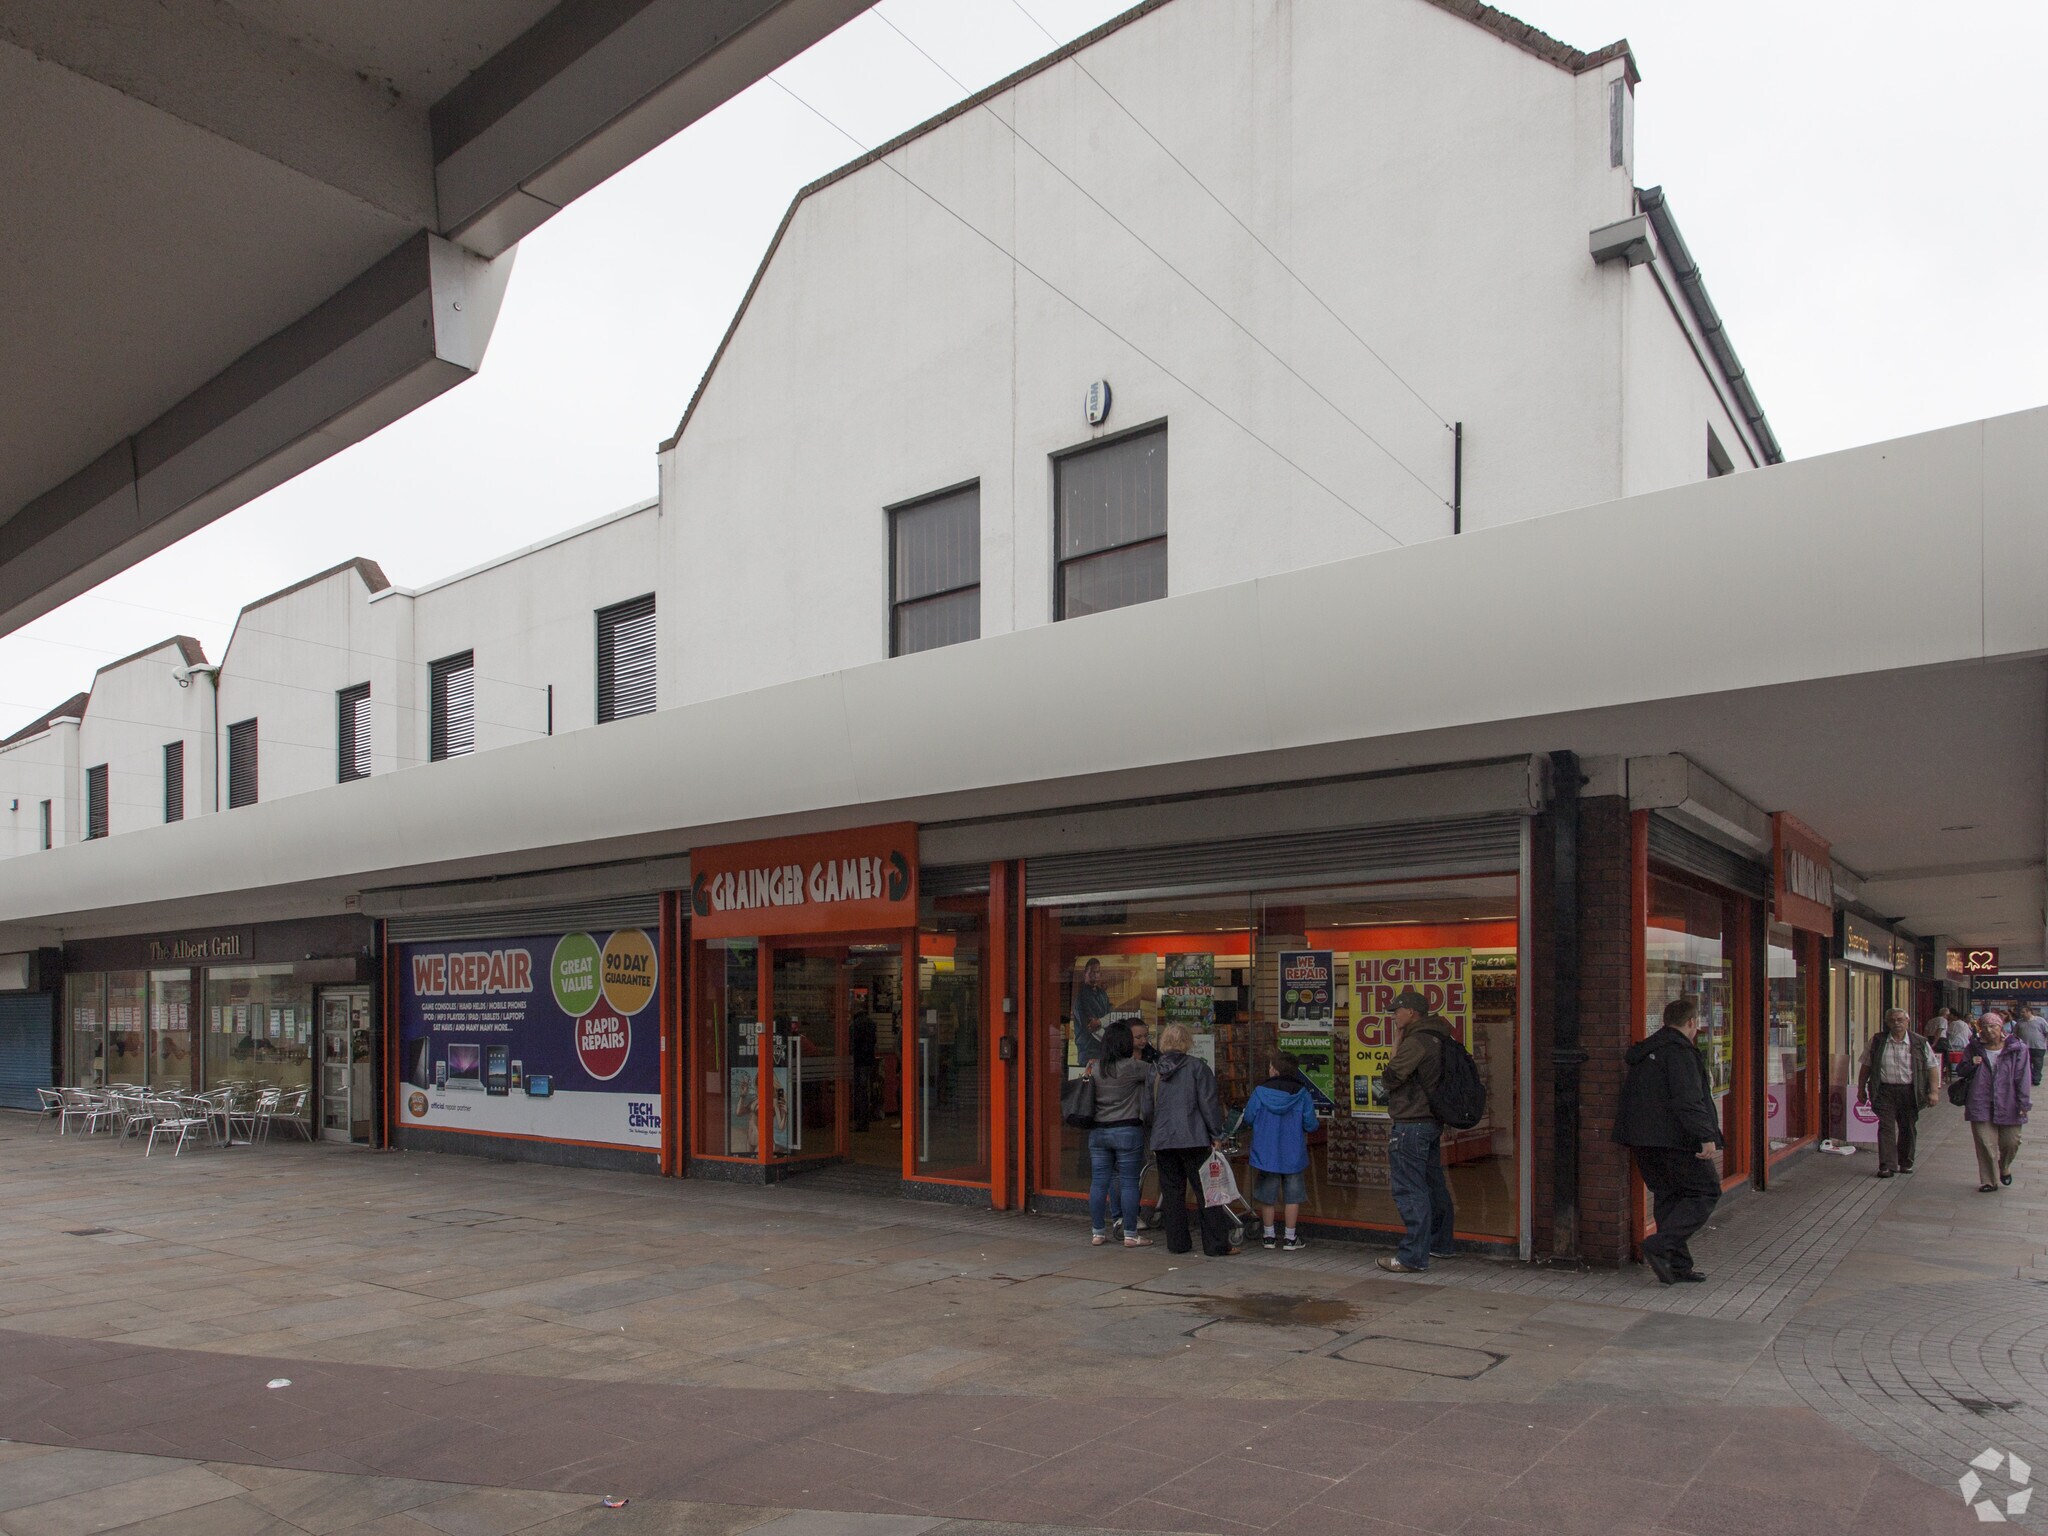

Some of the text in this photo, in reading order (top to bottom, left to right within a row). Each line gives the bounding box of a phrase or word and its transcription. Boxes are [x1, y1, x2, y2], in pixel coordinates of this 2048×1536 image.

[711, 856, 883, 911] GRAINGER GAMES
[150, 935, 240, 960] The Albert Grill
[560, 957, 593, 975] GREAT
[606, 953, 650, 972] 90 DAY
[1297, 956, 1315, 968] WE
[1487, 958, 1506, 966] £20
[414, 950, 532, 994] WE REPAIR
[1285, 967, 1328, 980] REPAIR
[1355, 956, 1467, 983] HIGHEST
[561, 975, 593, 993] VALUE
[605, 972, 651, 987] GUARANTEE
[1167, 987, 1212, 996] OUT NOW
[507, 1001, 527, 1009] PHONES
[503, 1012, 524, 1020] LAPTOPS
[585, 1017, 619, 1034] RAPID
[1356, 1015, 1466, 1047] GIN
[582, 1032, 625, 1050] REPAIRS
[1281, 1038, 1331, 1046] START SAVING
[1357, 1052, 1372, 1060] ON
[431, 1102, 444, 1110] official
[628, 1102, 652, 1115] TECH
[629, 1114, 661, 1128] CENTR
